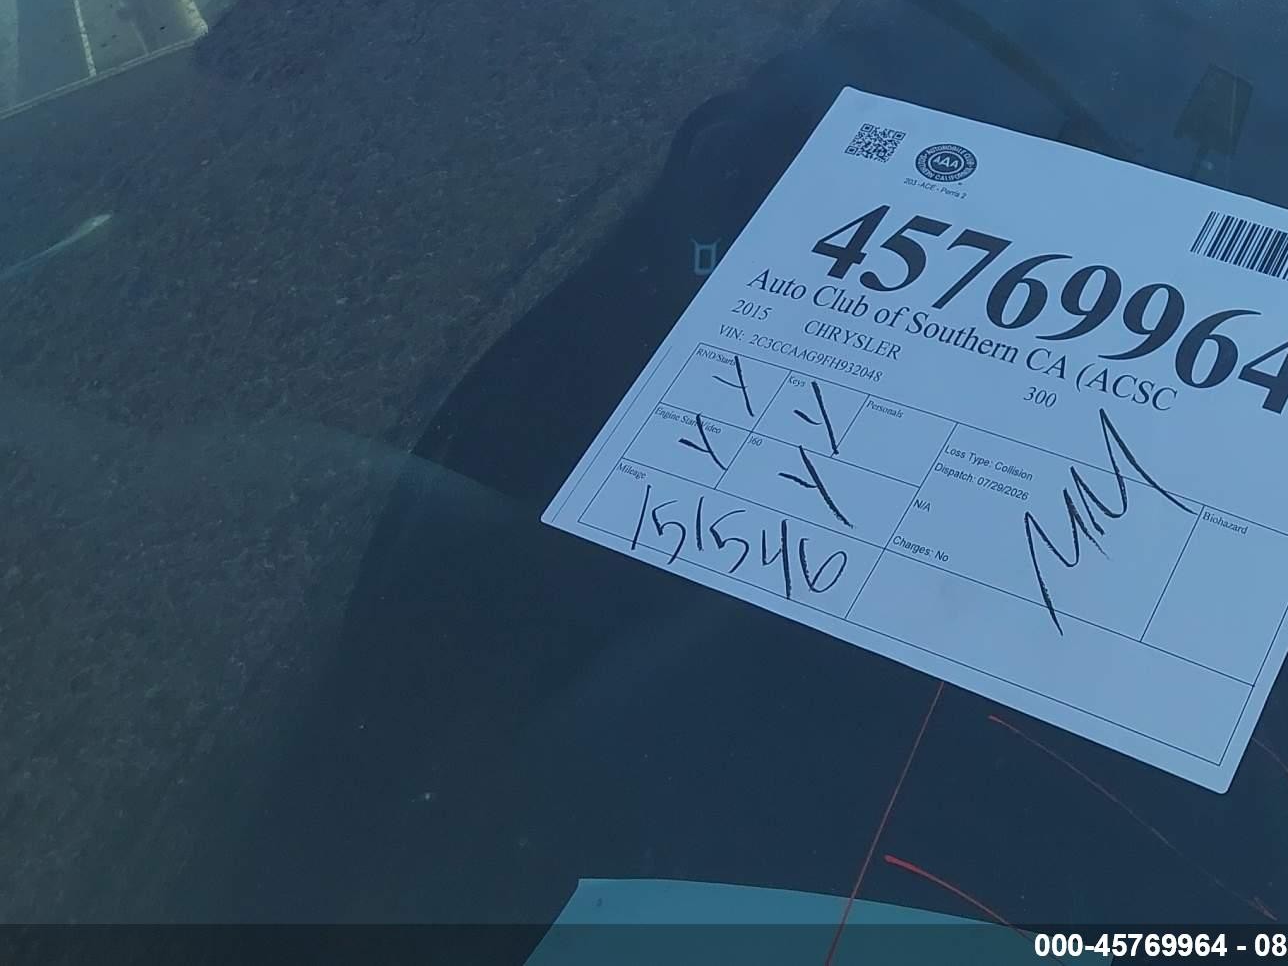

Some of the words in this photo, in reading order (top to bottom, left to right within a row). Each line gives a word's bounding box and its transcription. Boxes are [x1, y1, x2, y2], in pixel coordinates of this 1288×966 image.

[932, 155, 960, 169] AAA
[746, 268, 807, 300] Auto
[813, 285, 869, 318] Club
[874, 306, 910, 328] of
[905, 312, 1019, 364] Southern
[1026, 347, 1067, 379] CA
[1075, 363, 1178, 411] (ACSC
[719, 324, 745, 341] VIN:
[749, 334, 884, 382] 2C3CCAAG9FH932048
[731, 299, 773, 321] 2015
[804, 320, 902, 360] CHRYSLER
[1024, 387, 1058, 408] 300
[788, 375, 806, 388] Keys
[655, 407, 681, 421] Engine
[866, 400, 904, 419] Personals
[617, 462, 647, 479] Mileage
[944, 444, 966, 459] Loss
[969, 452, 993, 468] Type:
[995, 461, 1033, 481] Collision
[934, 462, 976, 483] Dispatch:
[977, 476, 1029, 501] 07/29/2026
[913, 499, 932, 513] N/A
[1202, 511, 1249, 535] Biohazard
[892, 535, 934, 557] Charges:
[936, 550, 949, 562] No
